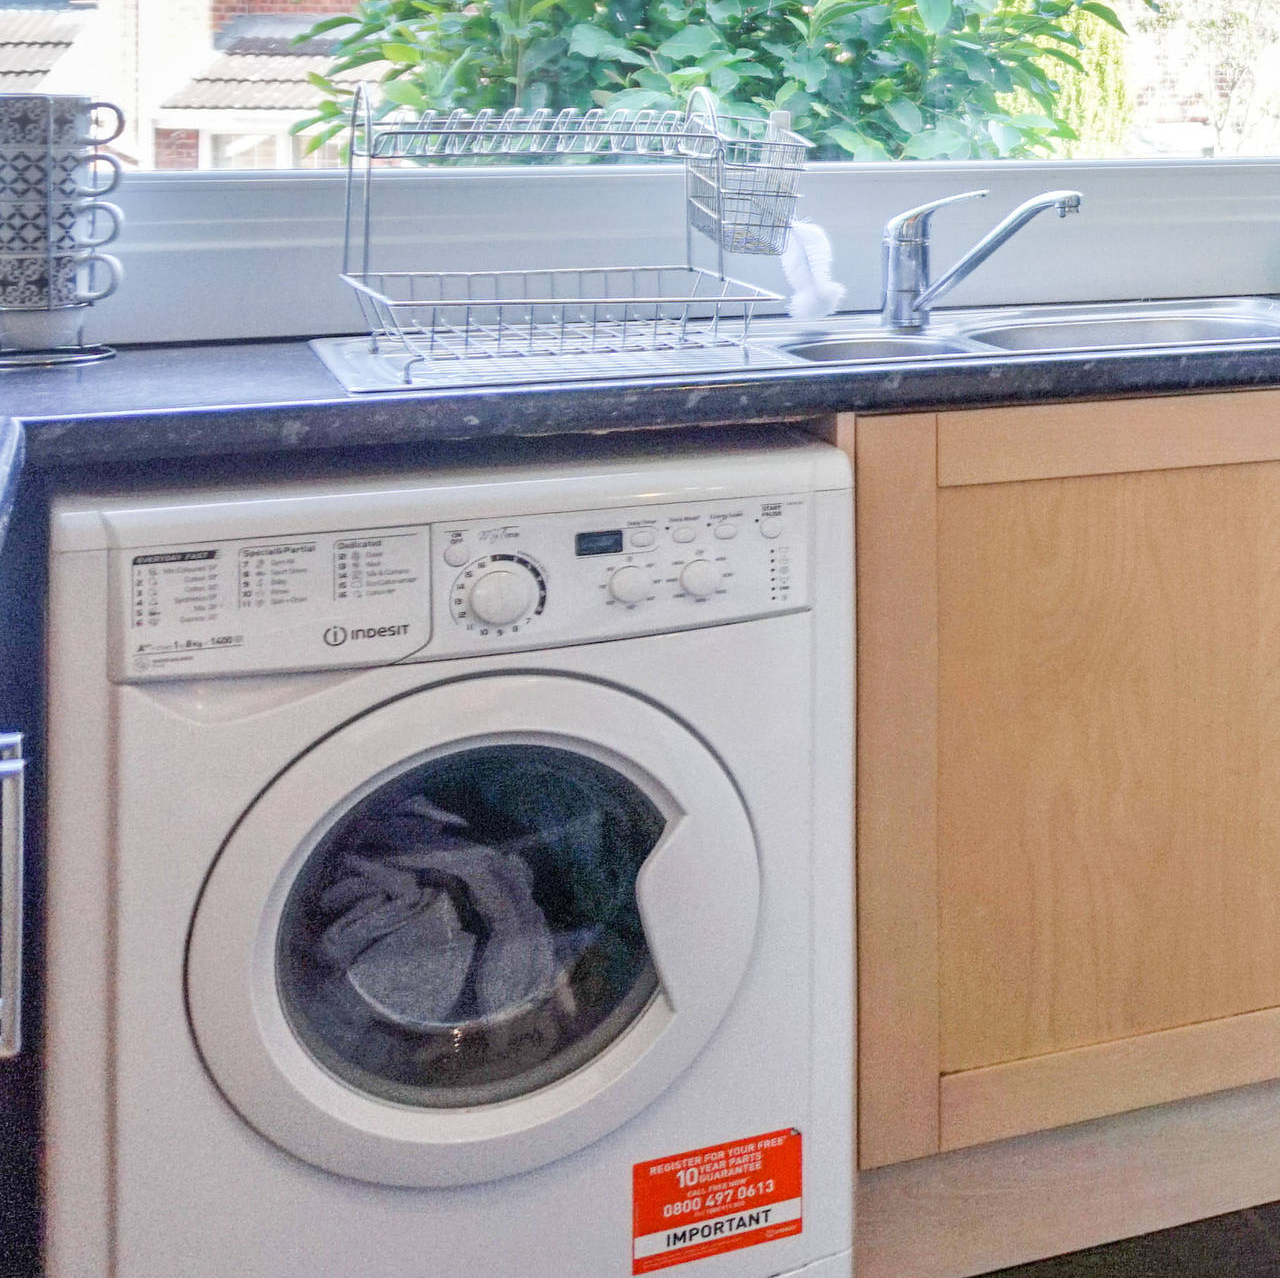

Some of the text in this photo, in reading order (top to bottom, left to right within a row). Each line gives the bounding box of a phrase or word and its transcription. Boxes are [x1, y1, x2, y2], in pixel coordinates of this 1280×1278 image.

[338, 540, 382, 550] Dedicated
[351, 623, 411, 641] INDESIT
[649, 1155, 701, 1176] REGISTER
[704, 1150, 725, 1163] FOR
[728, 1144, 755, 1156] YOUR
[676, 1152, 762, 1188] 10 YEAR PARTS
[699, 1161, 762, 1183] GUARANTEE
[663, 1198, 701, 1218] 0800
[705, 1189, 734, 1208] 497
[737, 1179, 775, 1200] 0613
[687, 1187, 706, 1198] CALL
[665, 1208, 773, 1248] IMPORTANT
